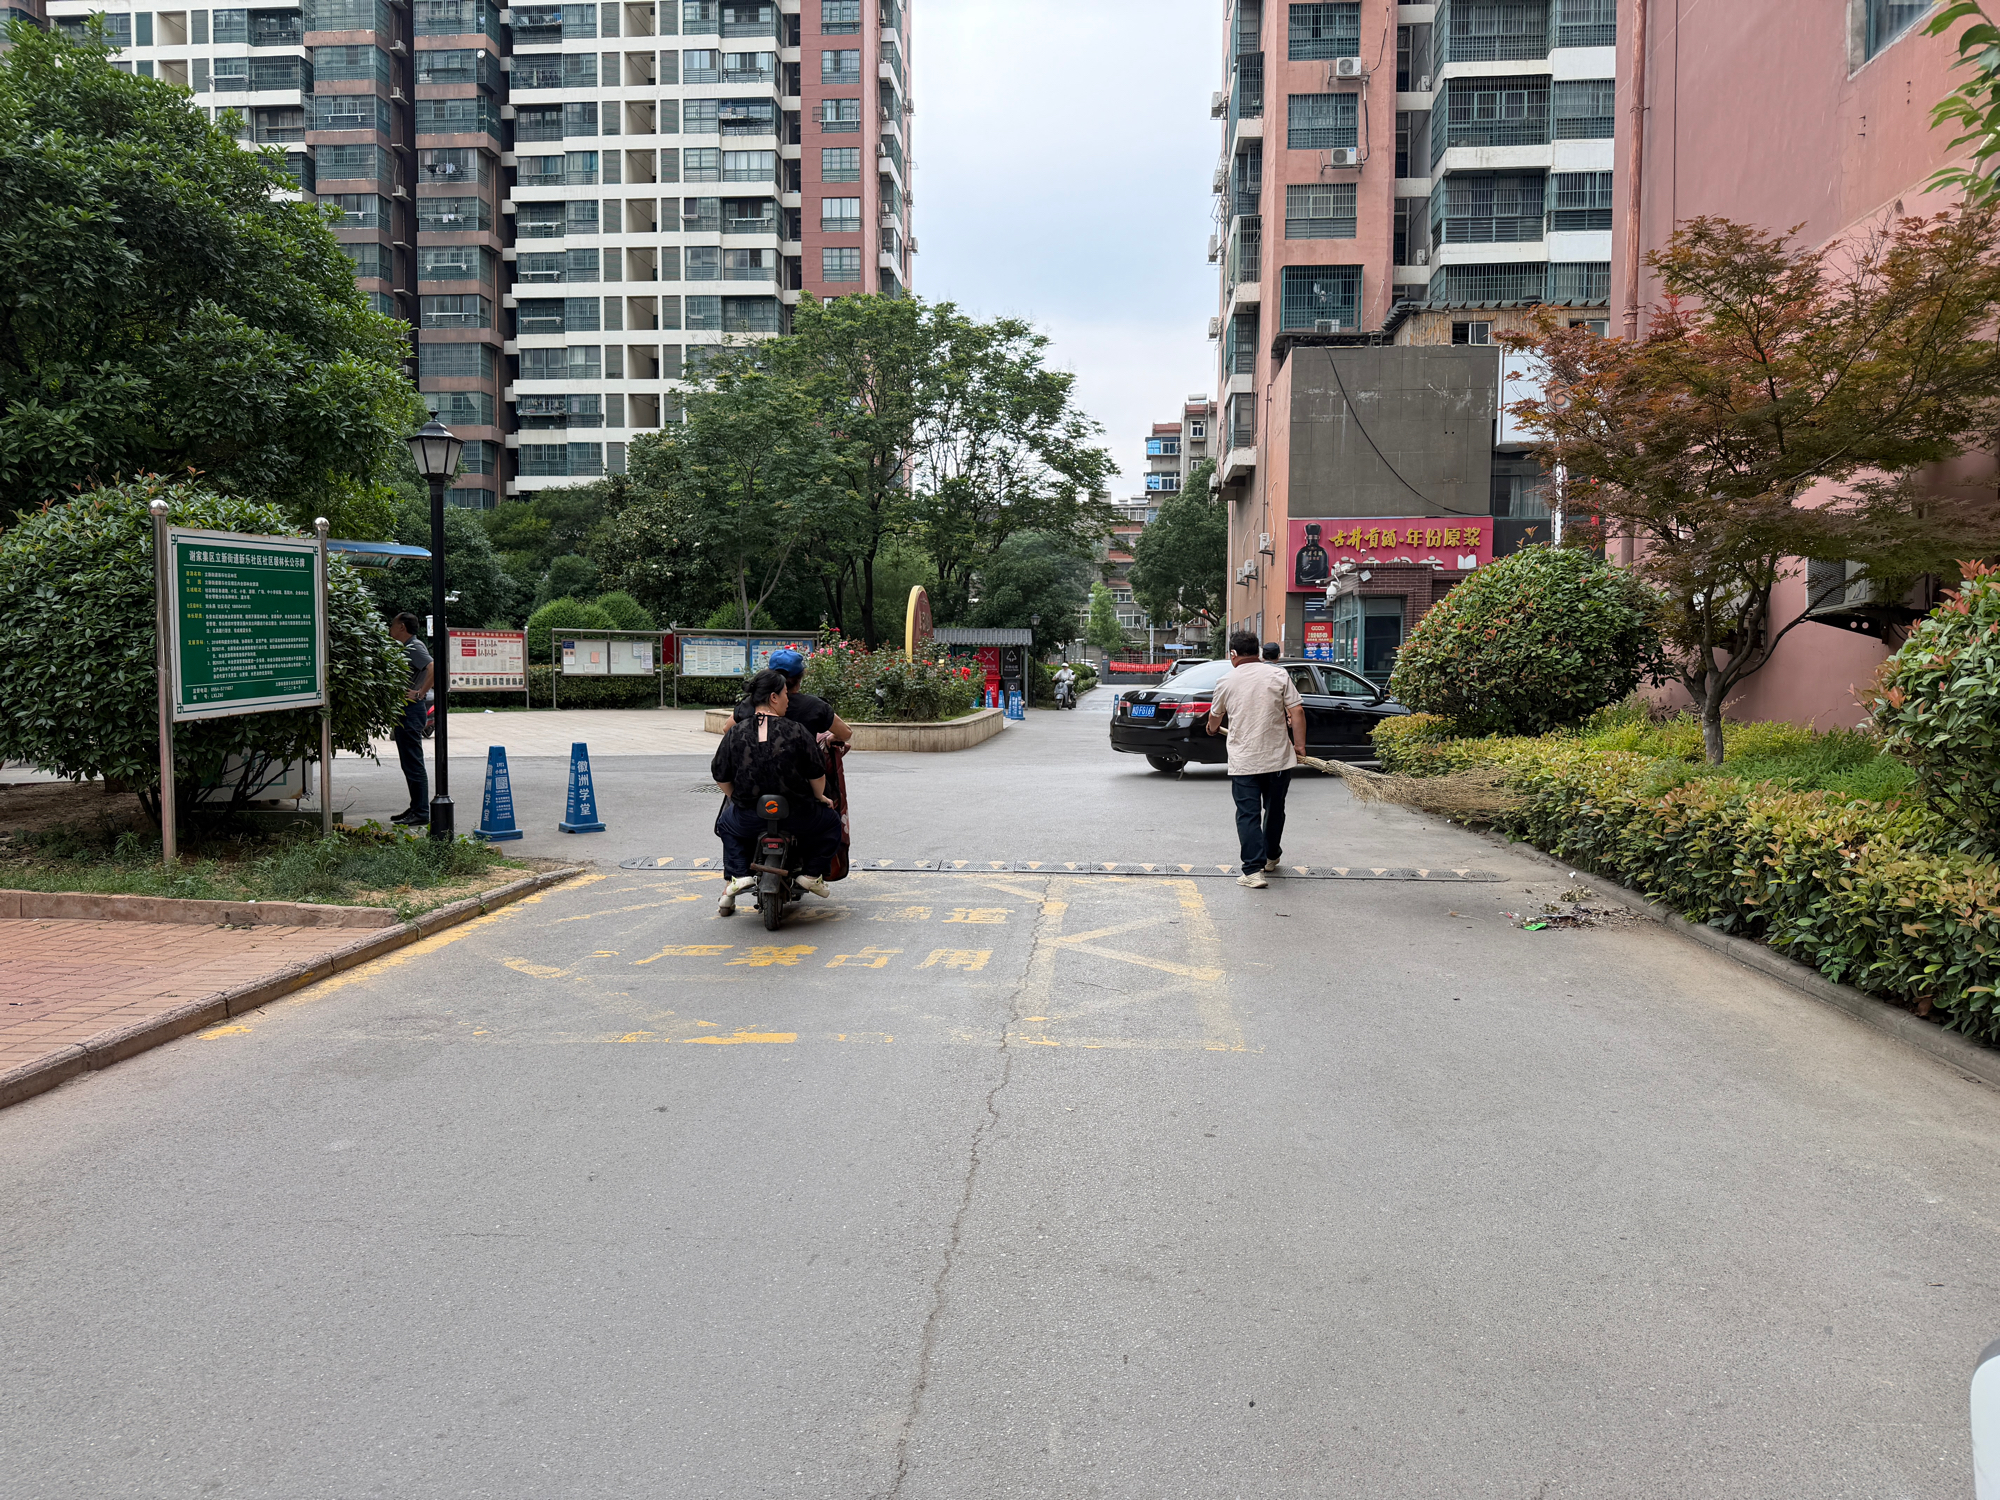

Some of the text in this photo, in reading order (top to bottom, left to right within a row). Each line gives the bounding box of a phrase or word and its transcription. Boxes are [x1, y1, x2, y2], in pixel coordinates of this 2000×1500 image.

[189, 550, 305, 568] 谢家集区立新街道新乐社区社区级林长公示牌
[577, 760, 592, 816] 徽洲学堂
[629, 944, 994, 971] 严禁占用
